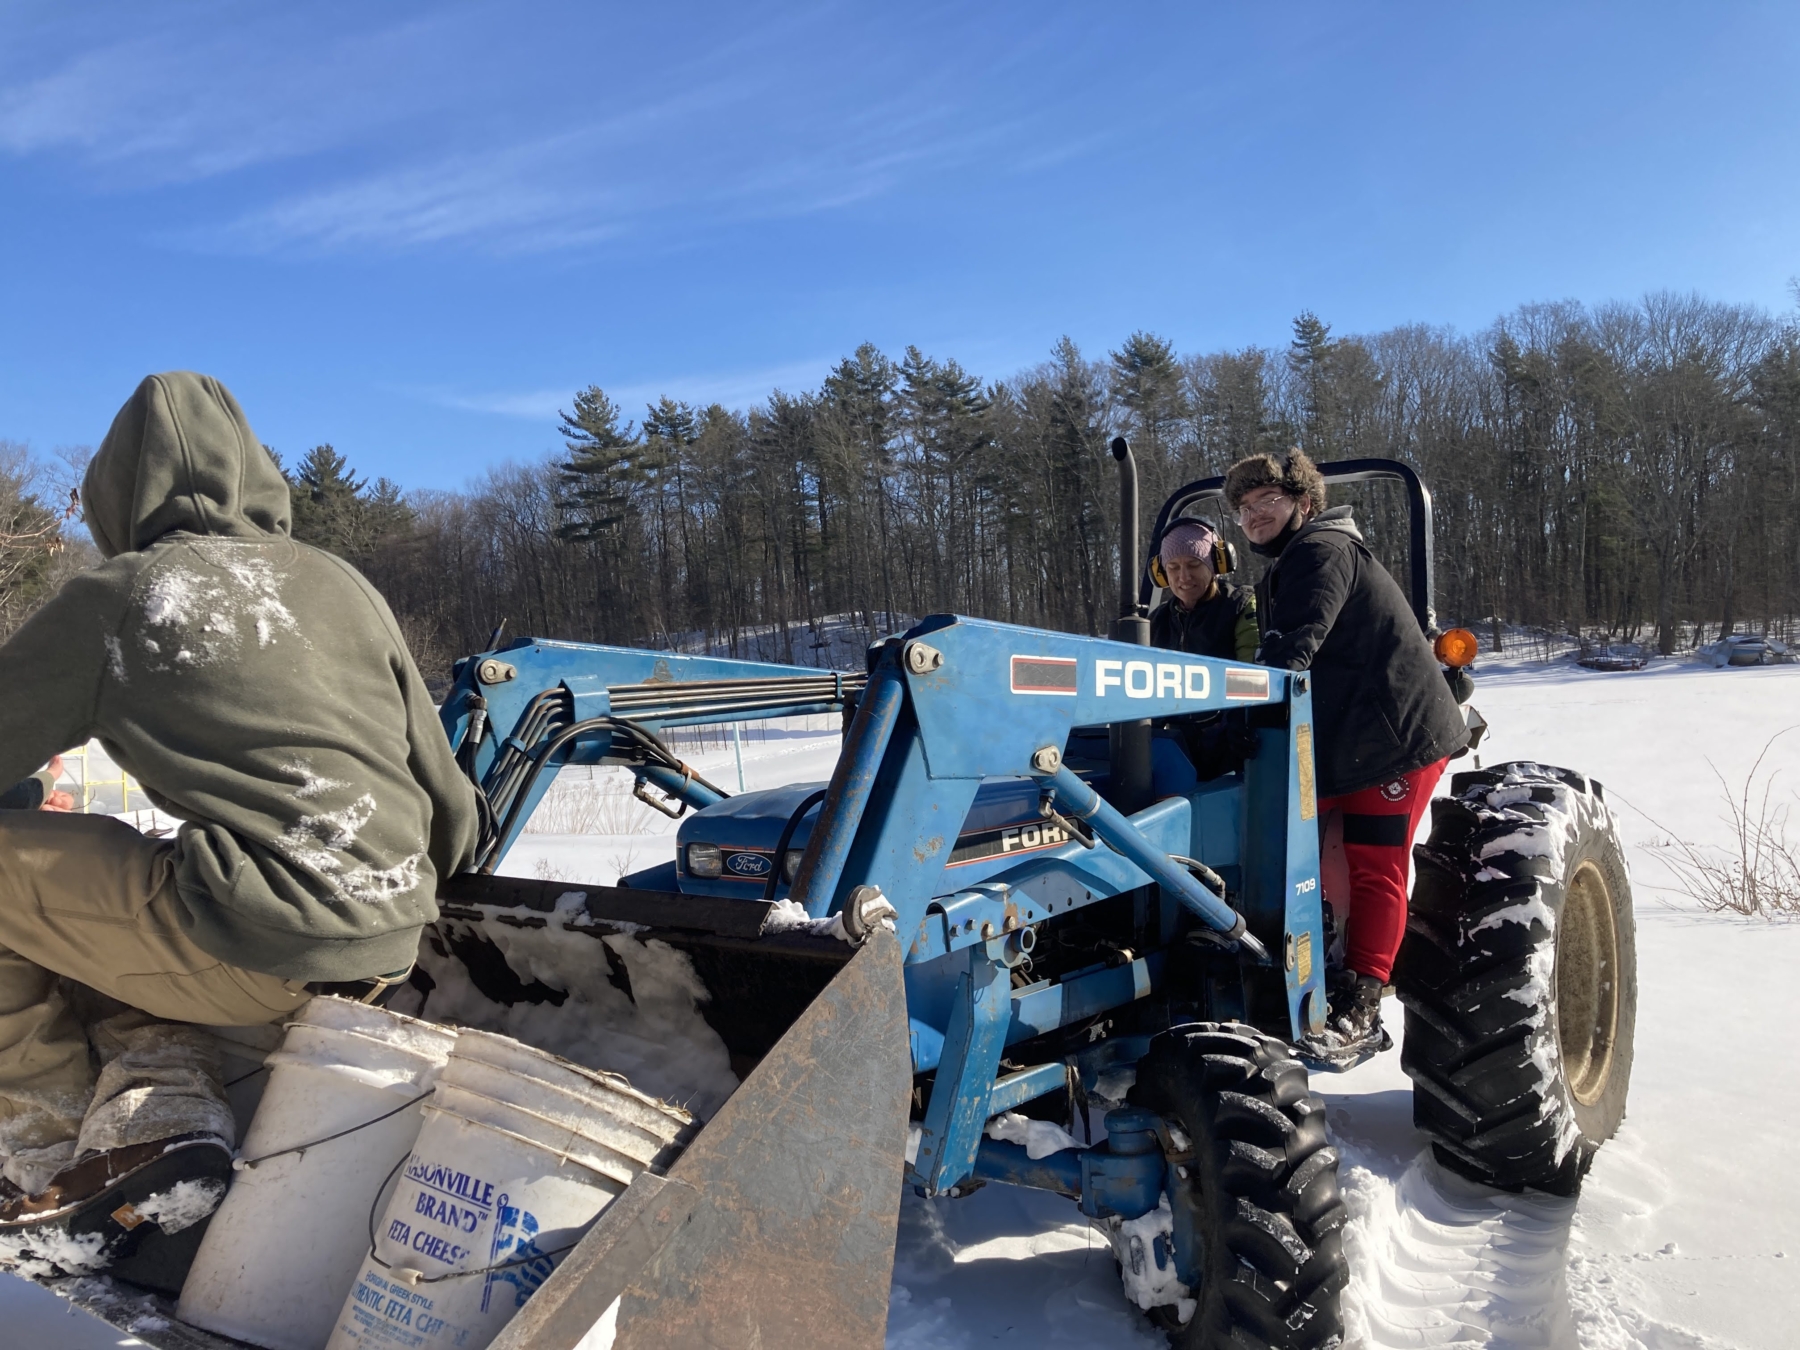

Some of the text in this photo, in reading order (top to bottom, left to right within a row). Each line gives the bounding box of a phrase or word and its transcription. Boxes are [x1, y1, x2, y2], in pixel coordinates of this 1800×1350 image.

[1095, 659, 1211, 700] FORD
[735, 855, 763, 872] Ford
[1295, 878, 1316, 896] 7109
[387, 1219, 412, 1246] FETA
[351, 1282, 386, 1312] THENTIC
[384, 1298, 413, 1326] FETA
[389, 1284, 411, 1303] GREEK
